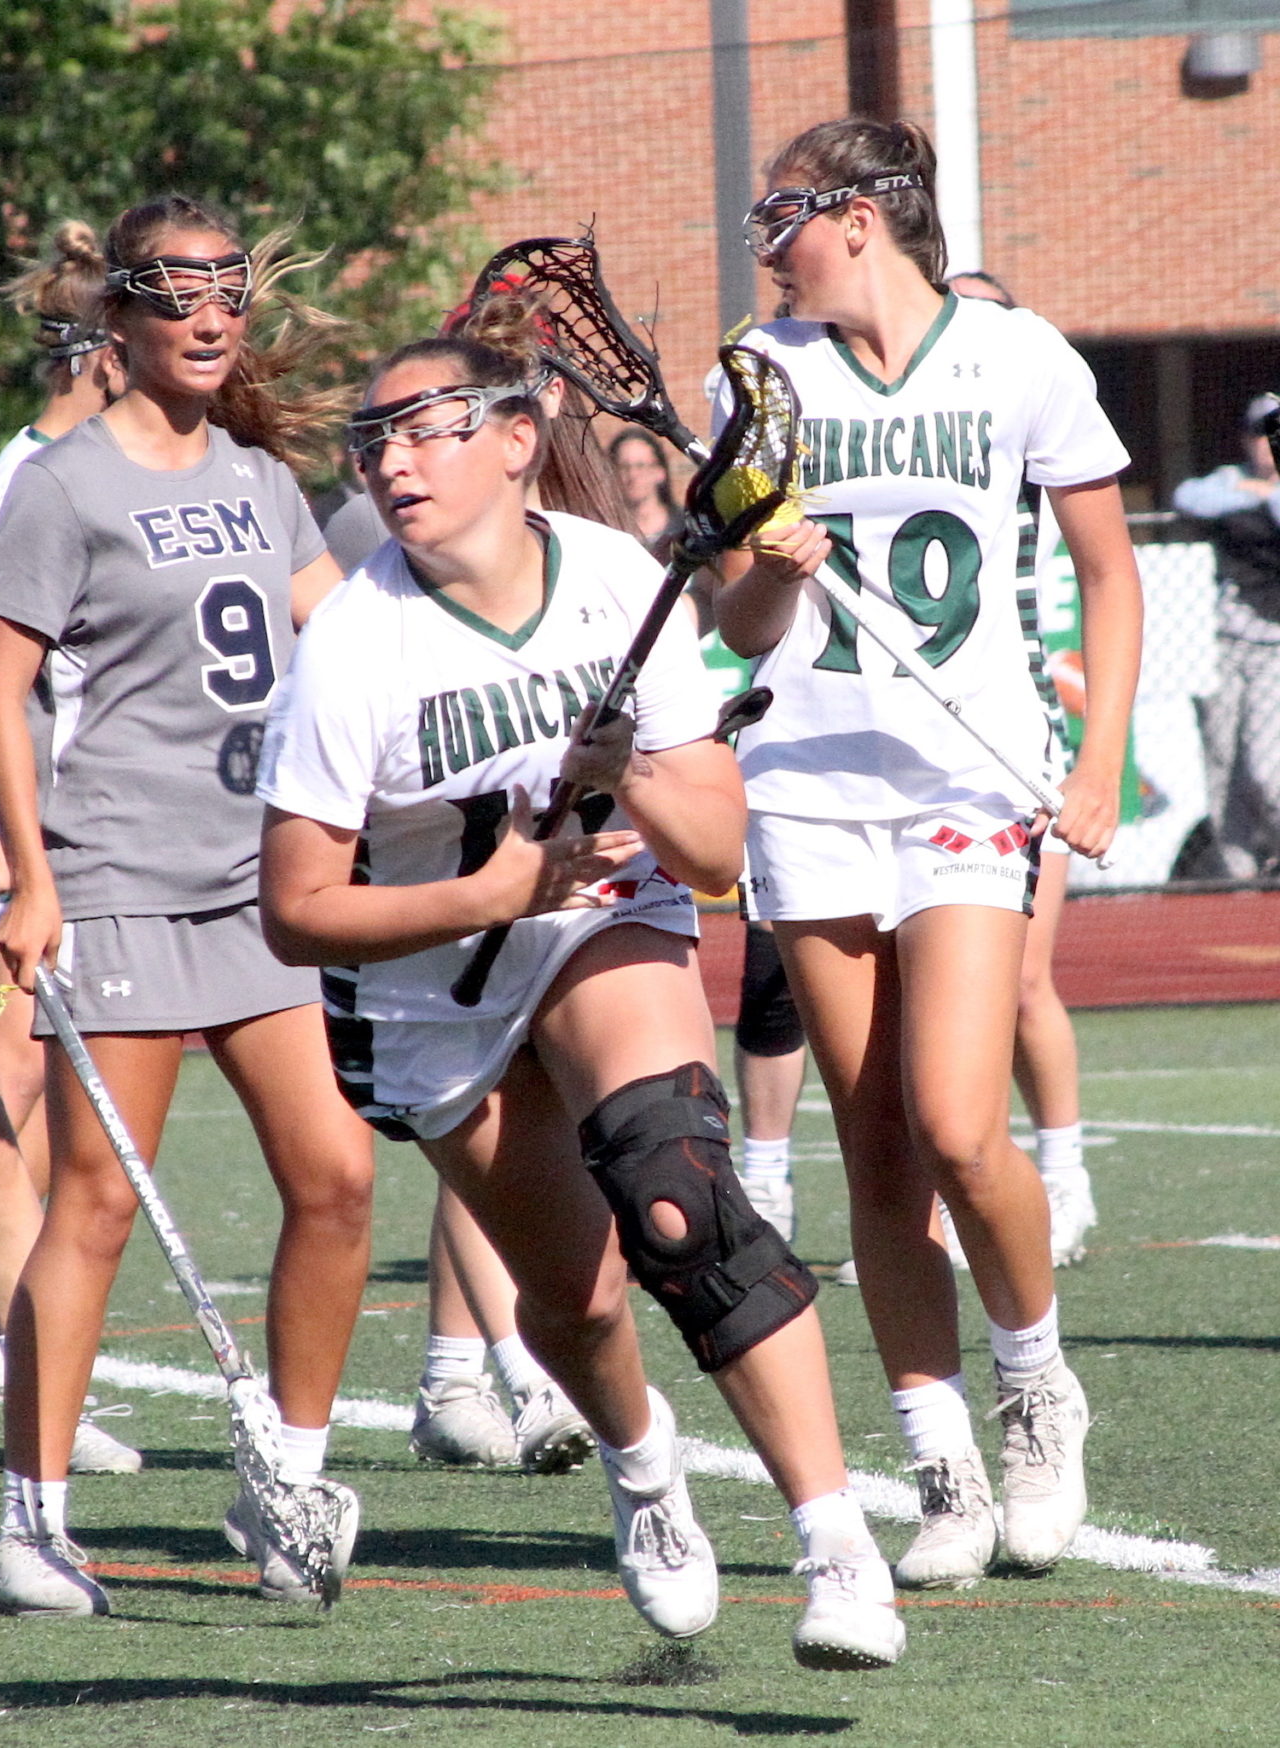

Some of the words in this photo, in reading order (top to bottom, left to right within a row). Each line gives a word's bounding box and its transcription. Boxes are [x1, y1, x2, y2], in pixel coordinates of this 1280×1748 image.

[815, 184, 860, 208] STX
[875, 174, 913, 191] STX
[793, 409, 993, 491] URRICANES
[128, 497, 275, 569] ESM
[803, 509, 983, 678] 19
[195, 573, 278, 713] 9
[933, 863, 997, 877] WESTHAMPTON
[87, 1076, 135, 1155] UNDER
